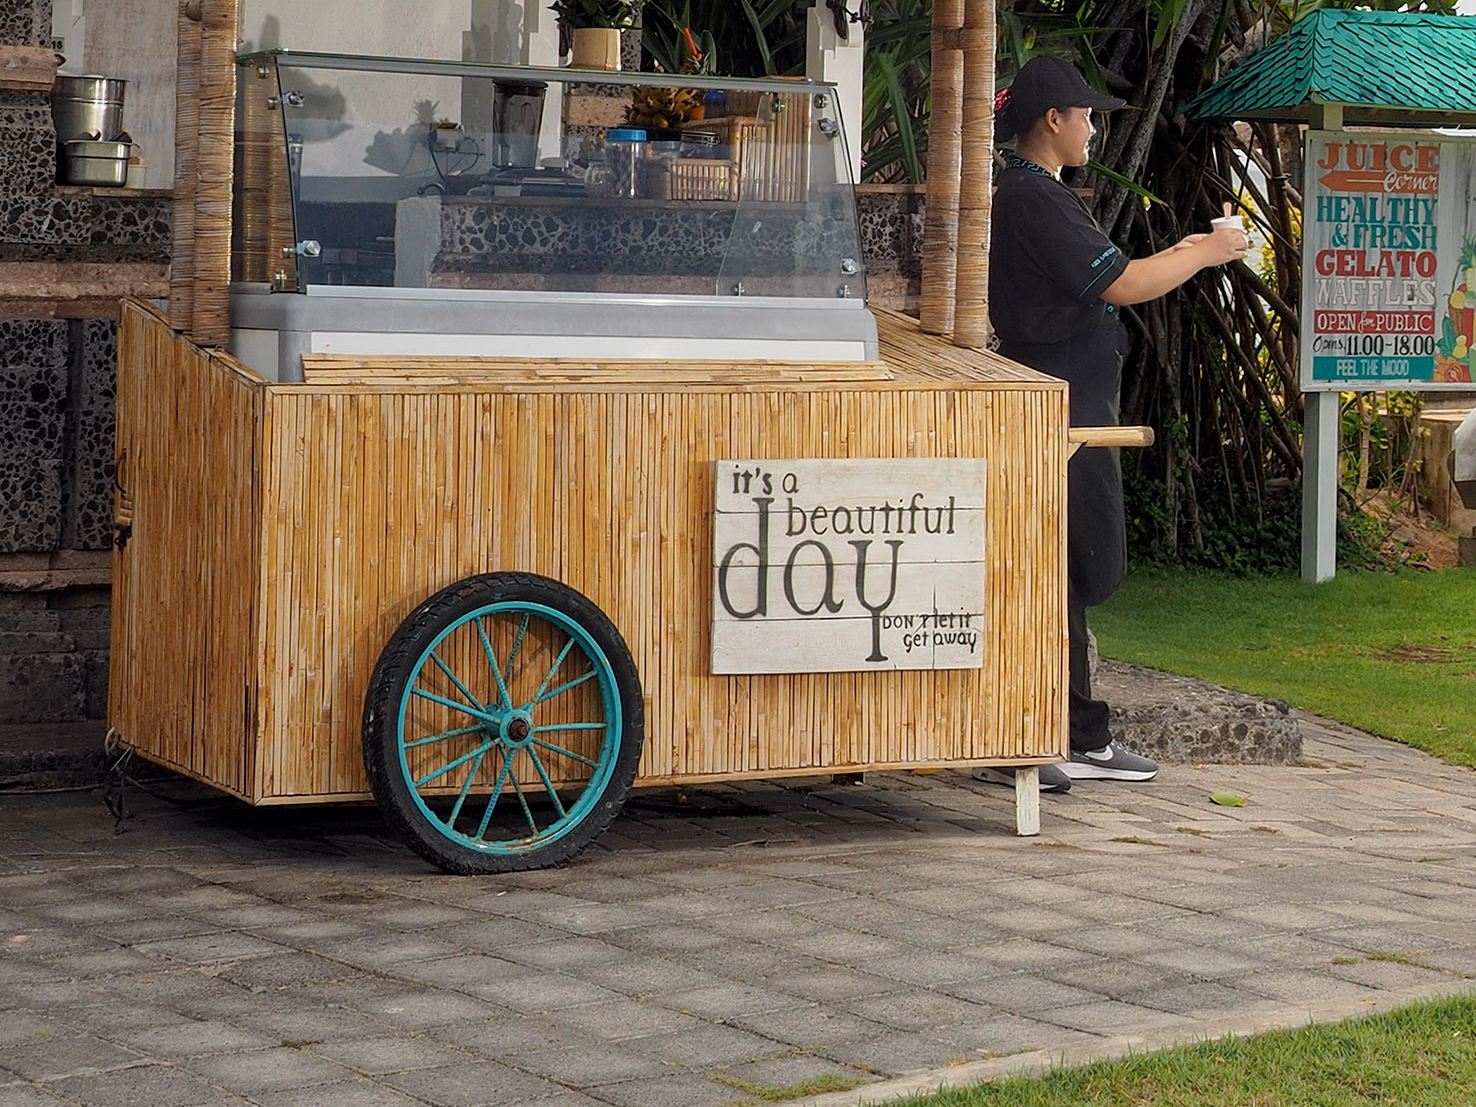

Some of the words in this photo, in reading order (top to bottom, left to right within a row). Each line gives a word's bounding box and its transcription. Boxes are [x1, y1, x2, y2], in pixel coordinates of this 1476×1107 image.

[1317, 143, 1440, 173] JUICE
[1383, 172, 1439, 192] Corner
[1316, 196, 1438, 225] HEALTHY
[1332, 223, 1348, 247] &
[1353, 224, 1437, 250] FRESH
[1315, 250, 1437, 278] GELATO
[1315, 278, 1437, 306] WAFFLES
[1317, 314, 1356, 331] OPEN
[1358, 311, 1376, 333] for
[1375, 314, 1433, 331] PUBLIC
[1337, 359, 1359, 376] FEEL
[1360, 359, 1379, 376] THE
[1381, 359, 1410, 376] MOOD
[732, 464, 773, 495] it's
[782, 472, 799, 494] a
[786, 492, 955, 537] beautiful
[718, 496, 905, 662] day
[934, 607, 954, 629] let
[959, 606, 971, 629] it
[903, 632, 929, 653] get
[933, 632, 977, 654] away
